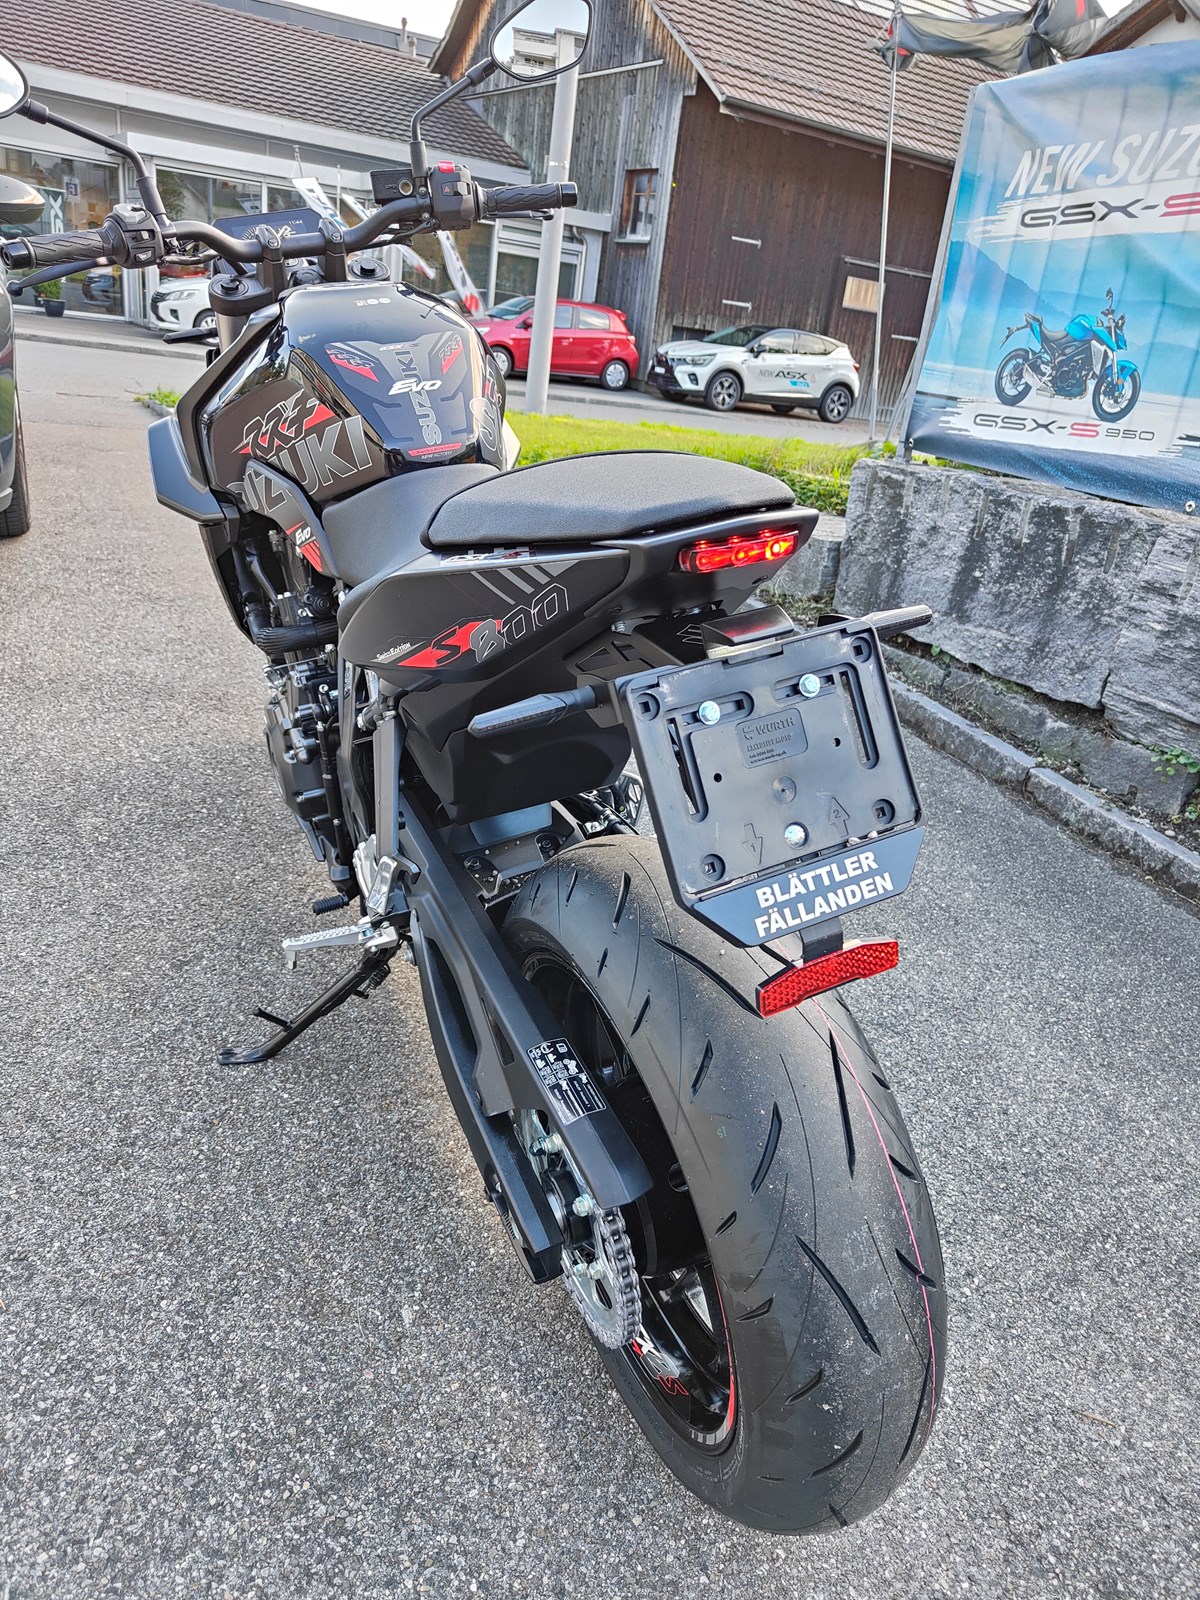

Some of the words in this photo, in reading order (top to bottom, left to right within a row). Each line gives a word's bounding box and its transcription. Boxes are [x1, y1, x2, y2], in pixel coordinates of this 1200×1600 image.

[1004, 140, 1105, 197] NEW
[395, 350, 443, 445] SUZUKI
[774, 370, 808, 381] ASX
[973, 413, 1101, 438] GSX-S
[1104, 427, 1155, 441] 950
[832, 809, 841, 819] 2
[754, 872, 894, 938] FÄLLANDEN
[755, 851, 879, 908] BLÄTTLER
